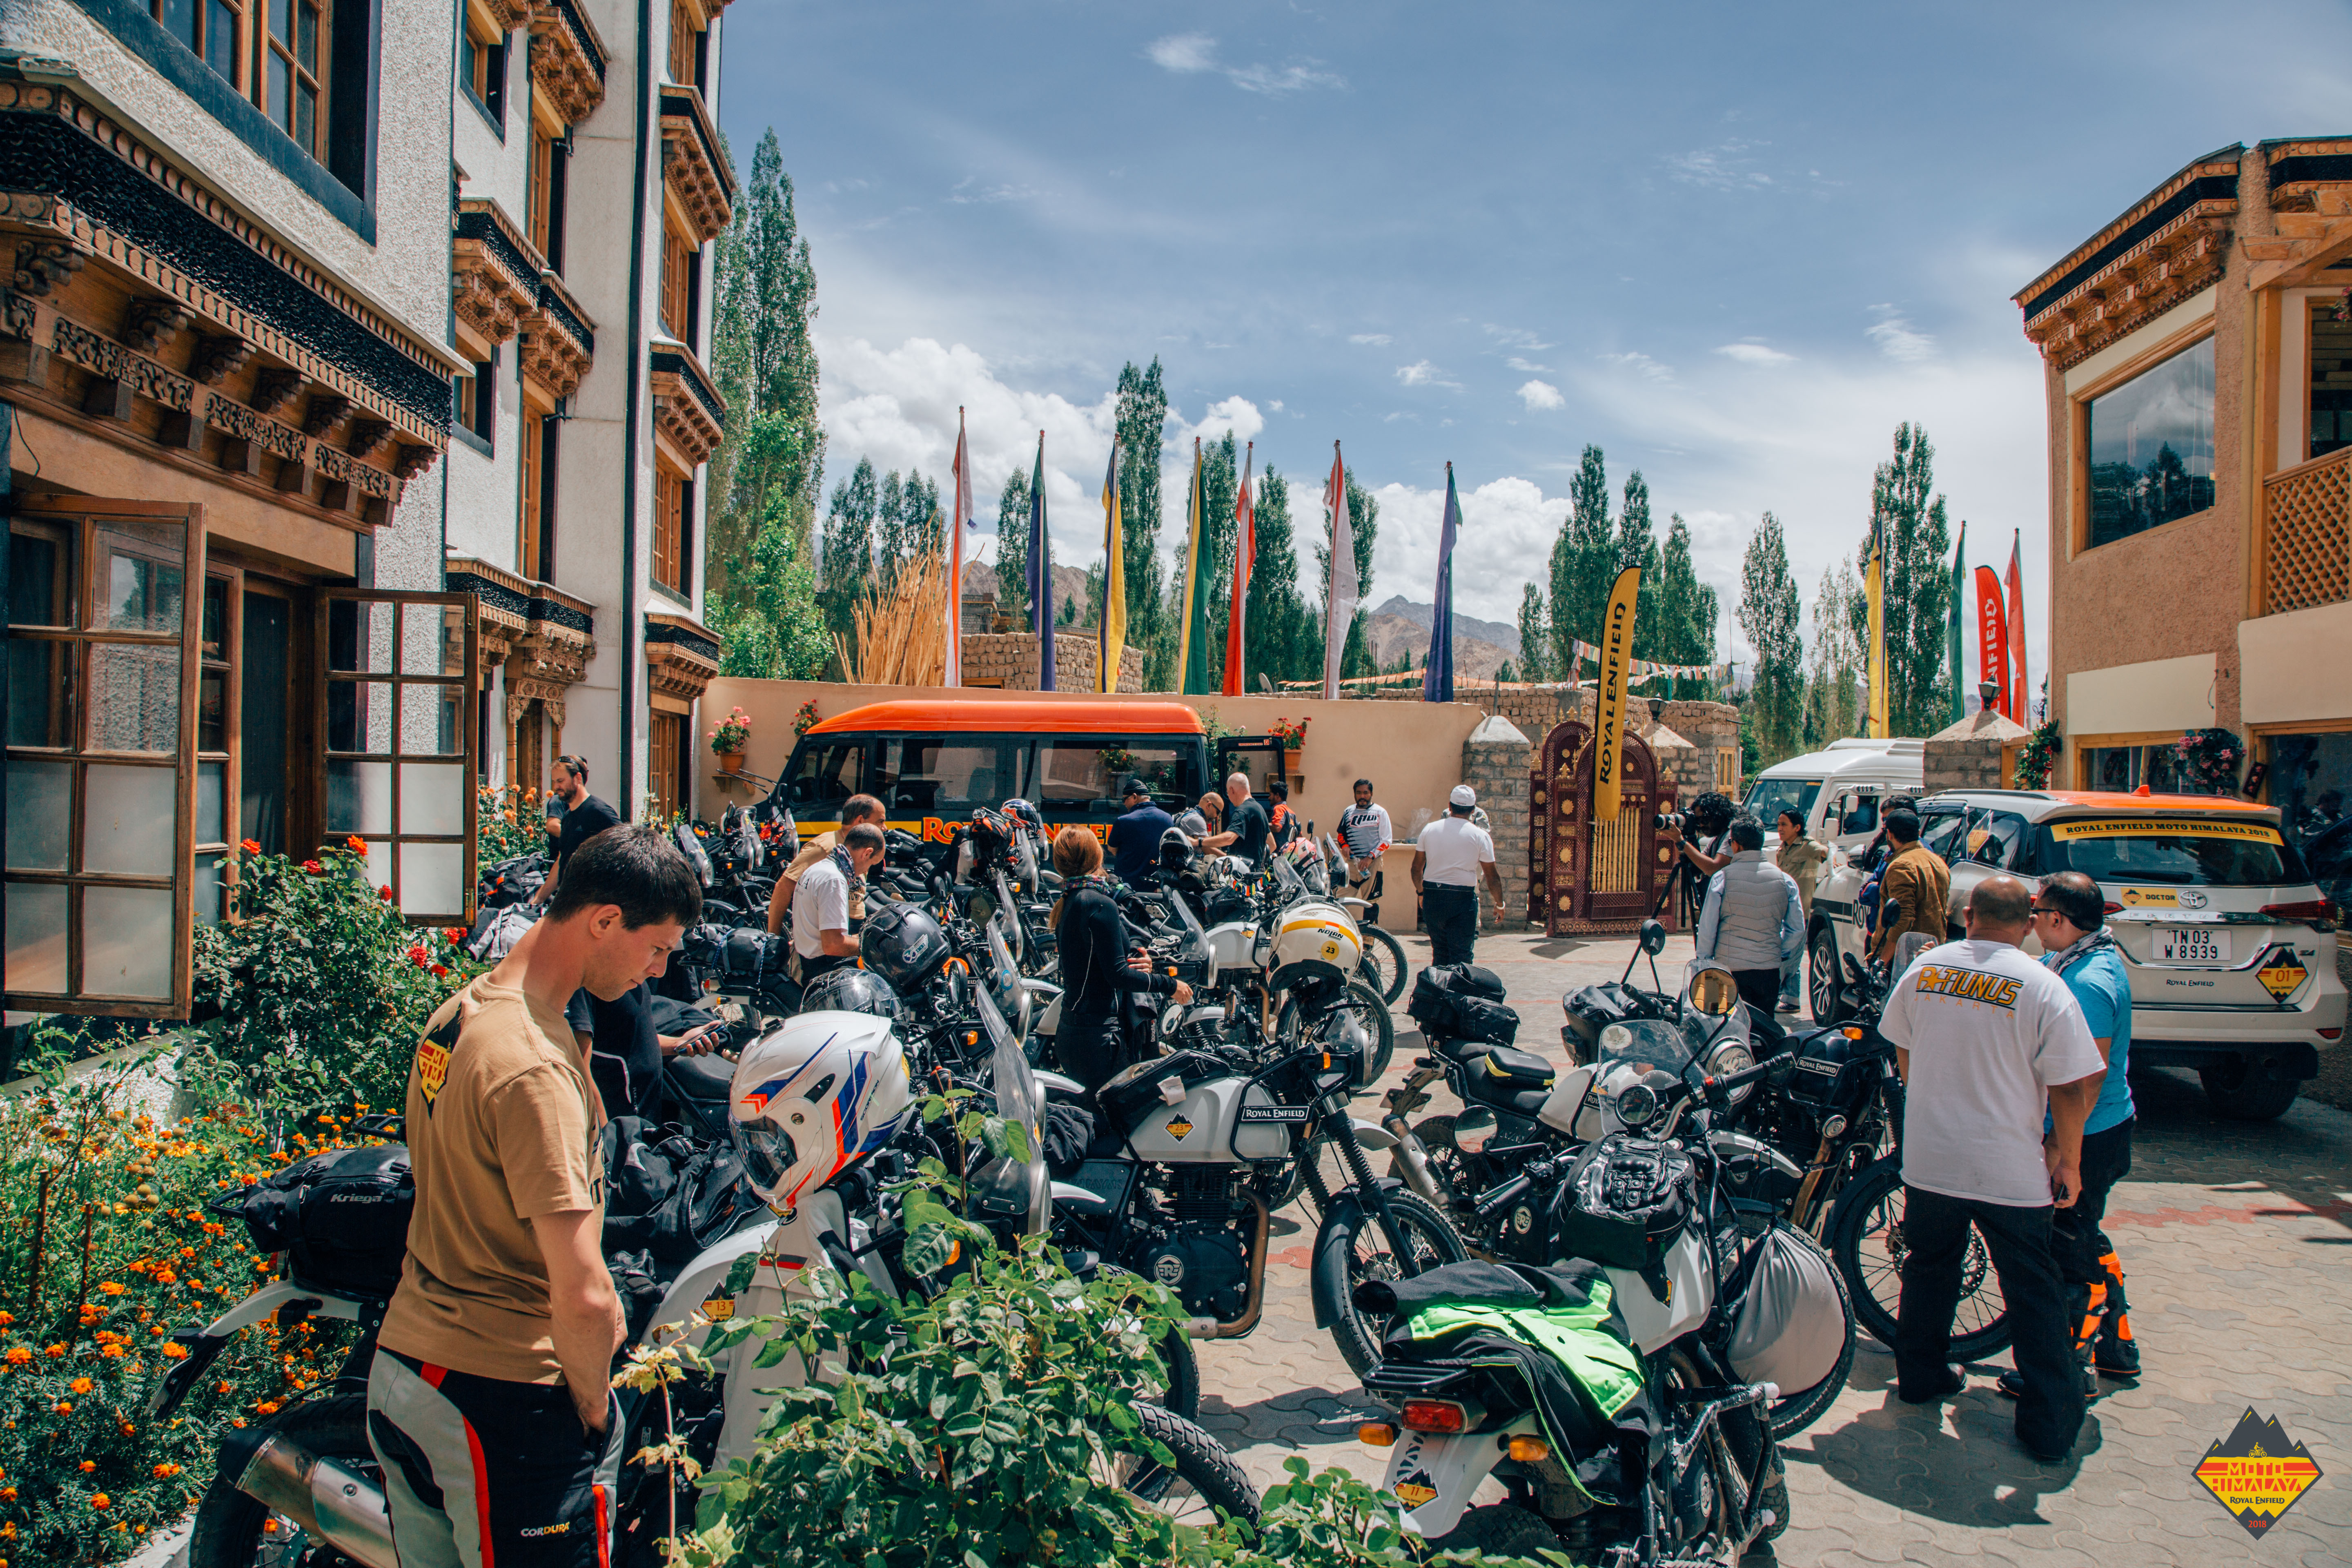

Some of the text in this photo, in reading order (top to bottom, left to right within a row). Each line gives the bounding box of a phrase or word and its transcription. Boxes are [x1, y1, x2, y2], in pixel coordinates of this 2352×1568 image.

[1985, 598, 1998, 681] NFIELD
[1599, 602, 1626, 784] ROYAL ENFIELD
[2066, 824, 2103, 833] ROYAL
[2191, 824, 2246, 834] HIMALAYA
[2248, 829, 2270, 837] 2018
[1853, 899, 1870, 929] ROY
[1317, 928, 1343, 940] NOLAN
[2172, 930, 2209, 944] TN 03
[2165, 944, 2218, 959] W 8939
[2276, 970, 2290, 982] 01
[1914, 993, 2014, 1019] JAKARTA
[1799, 1059, 1837, 1074] ROYAL ENFIELD
[1246, 1109, 1305, 1118] ROYAL ENFIELD
[330, 1193, 383, 1204] Kriega
[716, 1301, 726, 1311] 13
[1411, 1486, 1420, 1496] 11
[520, 1521, 570, 1537] CORDURA
